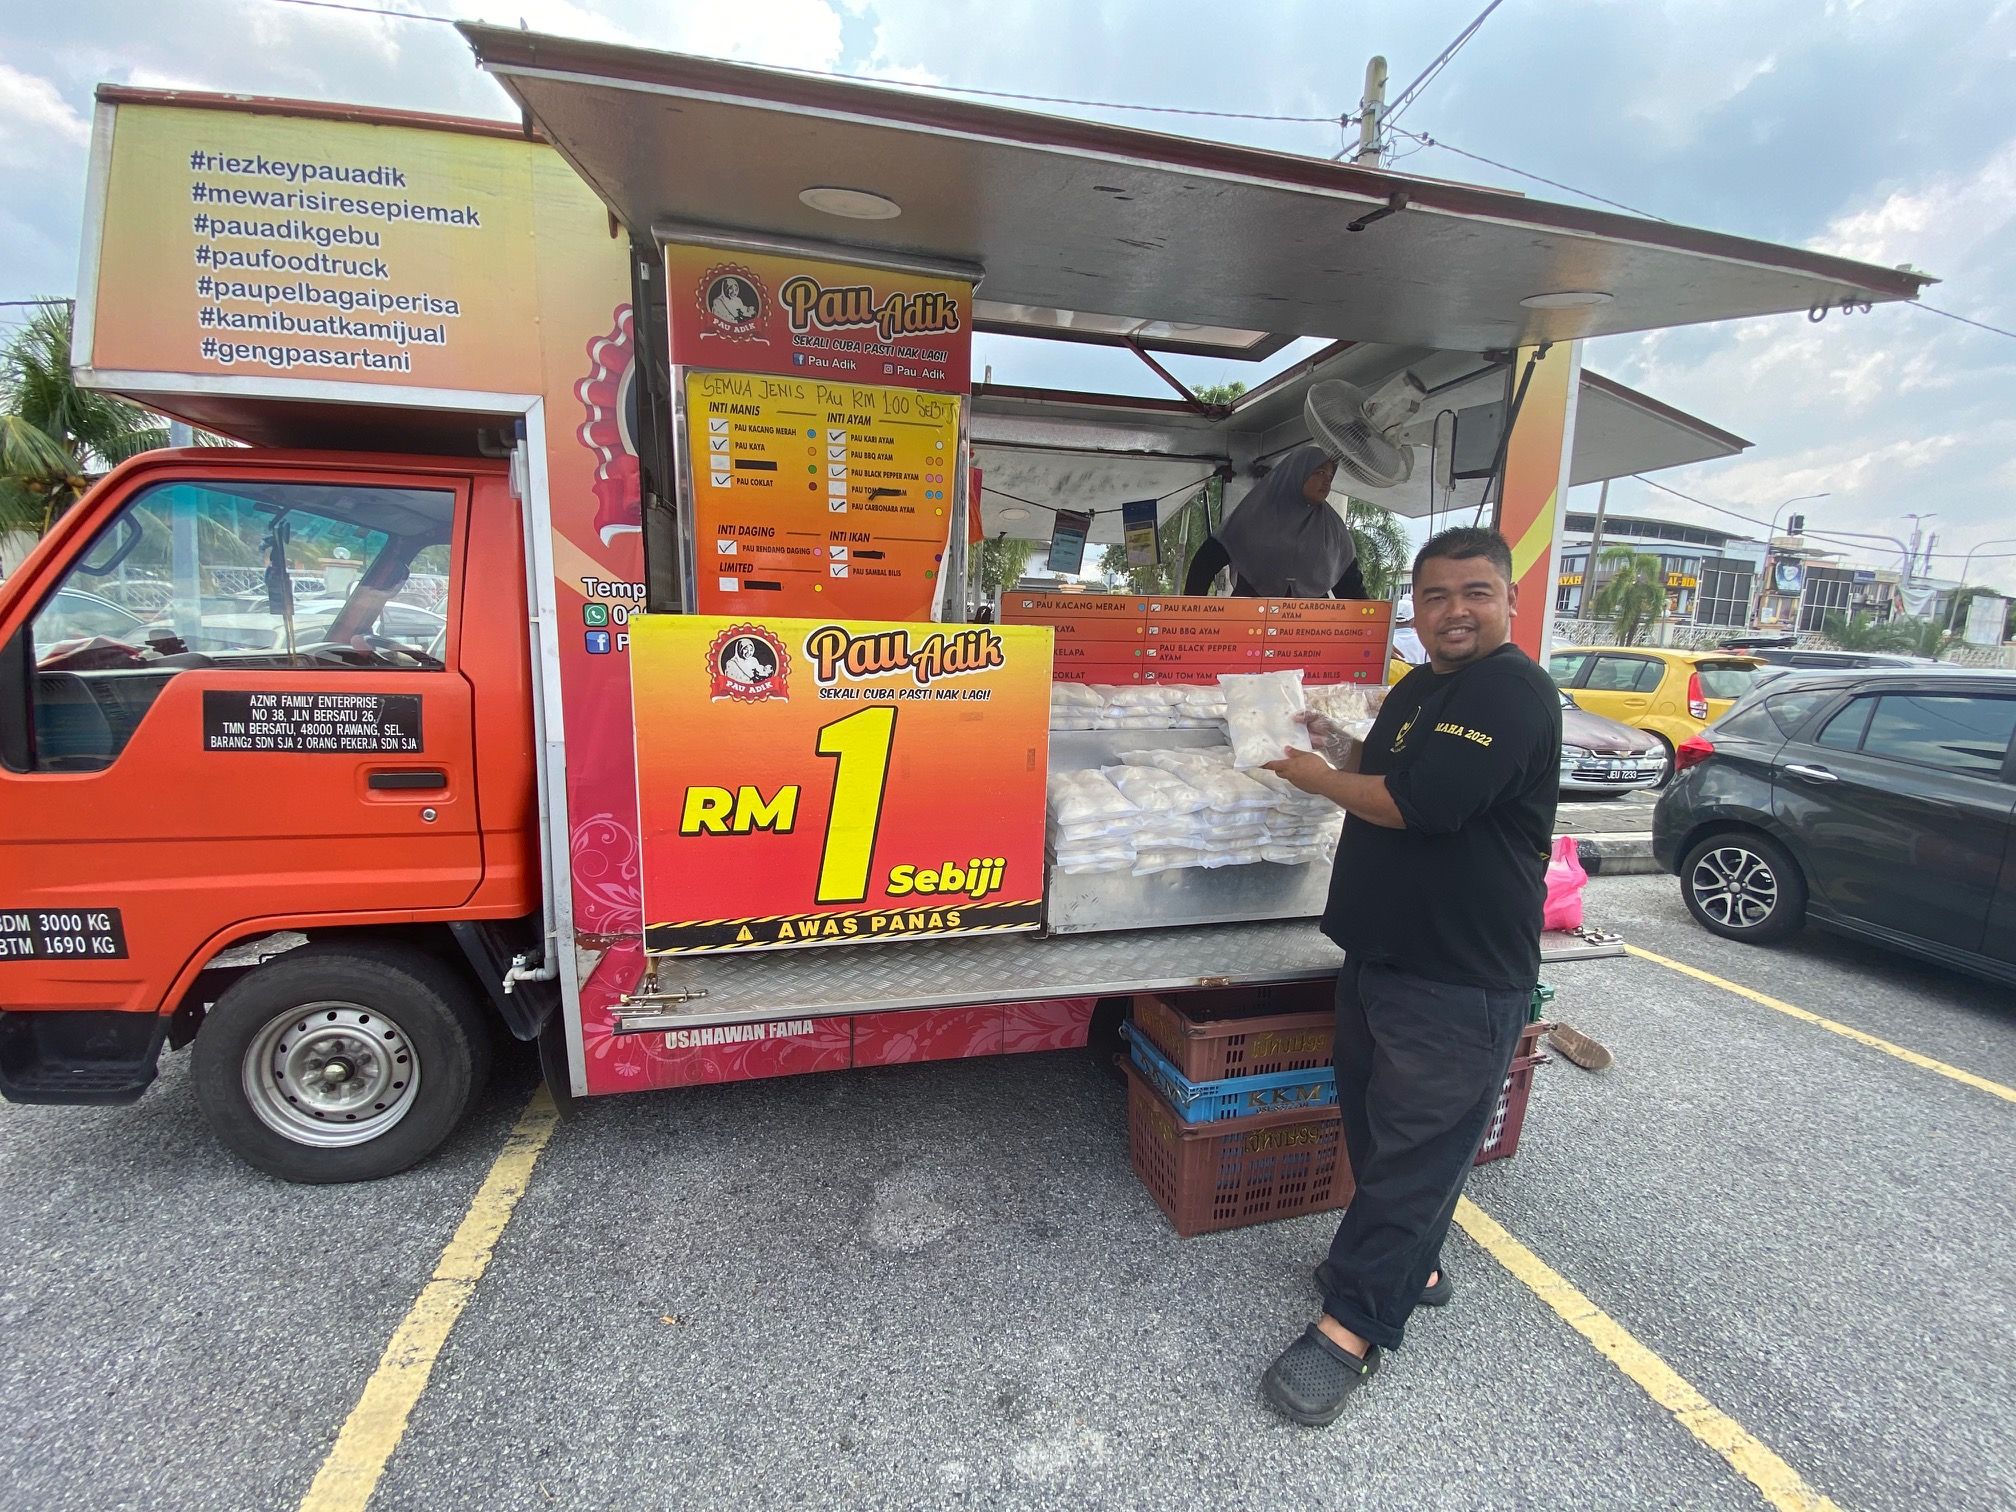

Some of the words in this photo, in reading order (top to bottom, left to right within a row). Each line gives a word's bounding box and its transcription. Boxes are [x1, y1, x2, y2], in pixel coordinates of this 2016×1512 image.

[190, 151, 407, 187] #riezkeypauadik
[192, 182, 480, 225] #mewarisiresepiemak
[194, 213, 380, 246] #pauadikgebu
[196, 245, 388, 278] #paufoodtruck
[198, 276, 459, 314] #paupelbagaiperisa
[781, 277, 875, 330] Pau
[875, 293, 959, 338] Adik
[200, 307, 445, 344] #kamibuatkamijual
[713, 318, 731, 330] PAU
[734, 322, 755, 333] ADIK
[202, 338, 411, 370] #gengpasartani
[793, 335, 829, 348] SEKALI
[832, 340, 860, 352] CUBA
[864, 344, 894, 356] PASTI
[897, 347, 919, 359] NAK
[921, 350, 948, 362] LAGI!
[808, 356, 829, 367] Pau
[832, 358, 857, 370] Adik
[897, 366, 945, 379] Pau_Adik
[701, 376, 752, 398] SEMUA
[758, 380, 804, 399] JENIS
[853, 389, 875, 409] RM
[709, 402, 727, 413] INTI
[730, 404, 760, 416] MANIS
[827, 412, 845, 423] INTI
[847, 414, 871, 426] AYAM
[749, 425, 774, 434] KACANG
[776, 427, 797, 436] MERAH
[735, 442, 748, 450] PAU
[749, 443, 765, 451] KAYA
[851, 434, 862, 442] PAU
[878, 437, 894, 445] AYAM
[851, 451, 863, 459] PAU
[864, 452, 876, 460] BBQ
[877, 453, 893, 461] AYAM
[851, 469, 863, 477] PAU
[864, 470, 881, 478] BLACK
[883, 471, 902, 480] PEPPER
[903, 472, 919, 480] AYAM
[751, 478, 773, 487] COKLAT
[851, 486, 863, 494] PAU
[851, 503, 863, 511] PAU
[865, 504, 898, 513] CARBONARA
[899, 505, 915, 513] AYAM
[718, 525, 736, 535] INTI
[738, 526, 775, 537] DAGING
[830, 531, 847, 541] INTI
[849, 532, 870, 543] IKAN
[756, 546, 785, 554] RENDANG
[787, 547, 811, 555] DAGING
[720, 562, 754, 573] LIMITED
[865, 568, 887, 576] SAMBAL
[888, 569, 901, 577] BILIS
[581, 577, 646, 602] Temp
[1055, 601, 1092, 610] KACANG
[1096, 602, 1126, 610] MERAH
[1055, 625, 1075, 633] KAYA
[1280, 628, 1293, 636] PAU
[807, 626, 908, 682] Pau
[910, 629, 1004, 683] Adik
[1054, 648, 1085, 656] KELAPA
[1160, 644, 1175, 652] PAU
[726, 680, 746, 692] PAU
[749, 681, 773, 694] ADIK
[819, 688, 859, 699] SEKALI
[864, 689, 894, 699] CUBA
[900, 689, 932, 700] PASTI
[936, 689, 959, 700] NAK
[962, 689, 991, 700] LAGI!
[250, 695, 277, 708] AZNR
[281, 695, 314, 708] FAMILY
[318, 696, 378, 708] ENTERPRISE
[252, 709, 267, 720] NO
[272, 709, 286, 722] 38,
[291, 709, 312, 721] JLN
[314, 710, 358, 722] BERSATU
[222, 722, 245, 734] TMN
[250, 723, 296, 736] BERSATU,
[300, 723, 332, 735] 48000
[337, 724, 380, 737] RAWANG,
[384, 724, 405, 735] SEL.
[211, 736, 252, 749] BARANG2
[256, 737, 274, 748] SDN
[277, 737, 293, 748] SJA
[297, 738, 303, 748] 2
[306, 738, 337, 749] ORANG
[341, 738, 378, 749] PEKERJA
[381, 738, 399, 749] SDN
[401, 738, 417, 750] SJA
[1464, 729, 1493, 747] 2022
[1621, 770, 1637, 779] 7233
[679, 785, 801, 836] RM
[814, 705, 899, 904] 1
[885, 857, 1007, 899] Sebiji
[0, 914, 31, 932] DM
[39, 914, 82, 931] 3000
[87, 913, 111, 931] KG
[777, 917, 858, 940] AWAS
[872, 911, 961, 933] PANAS
[44, 936, 86, 953] 1690
[92, 937, 115, 954] KG
[665, 1023, 765, 1050] USAHAWAN
[769, 1019, 814, 1039] FAMA
[1247, 1083, 1323, 1107] KKM
